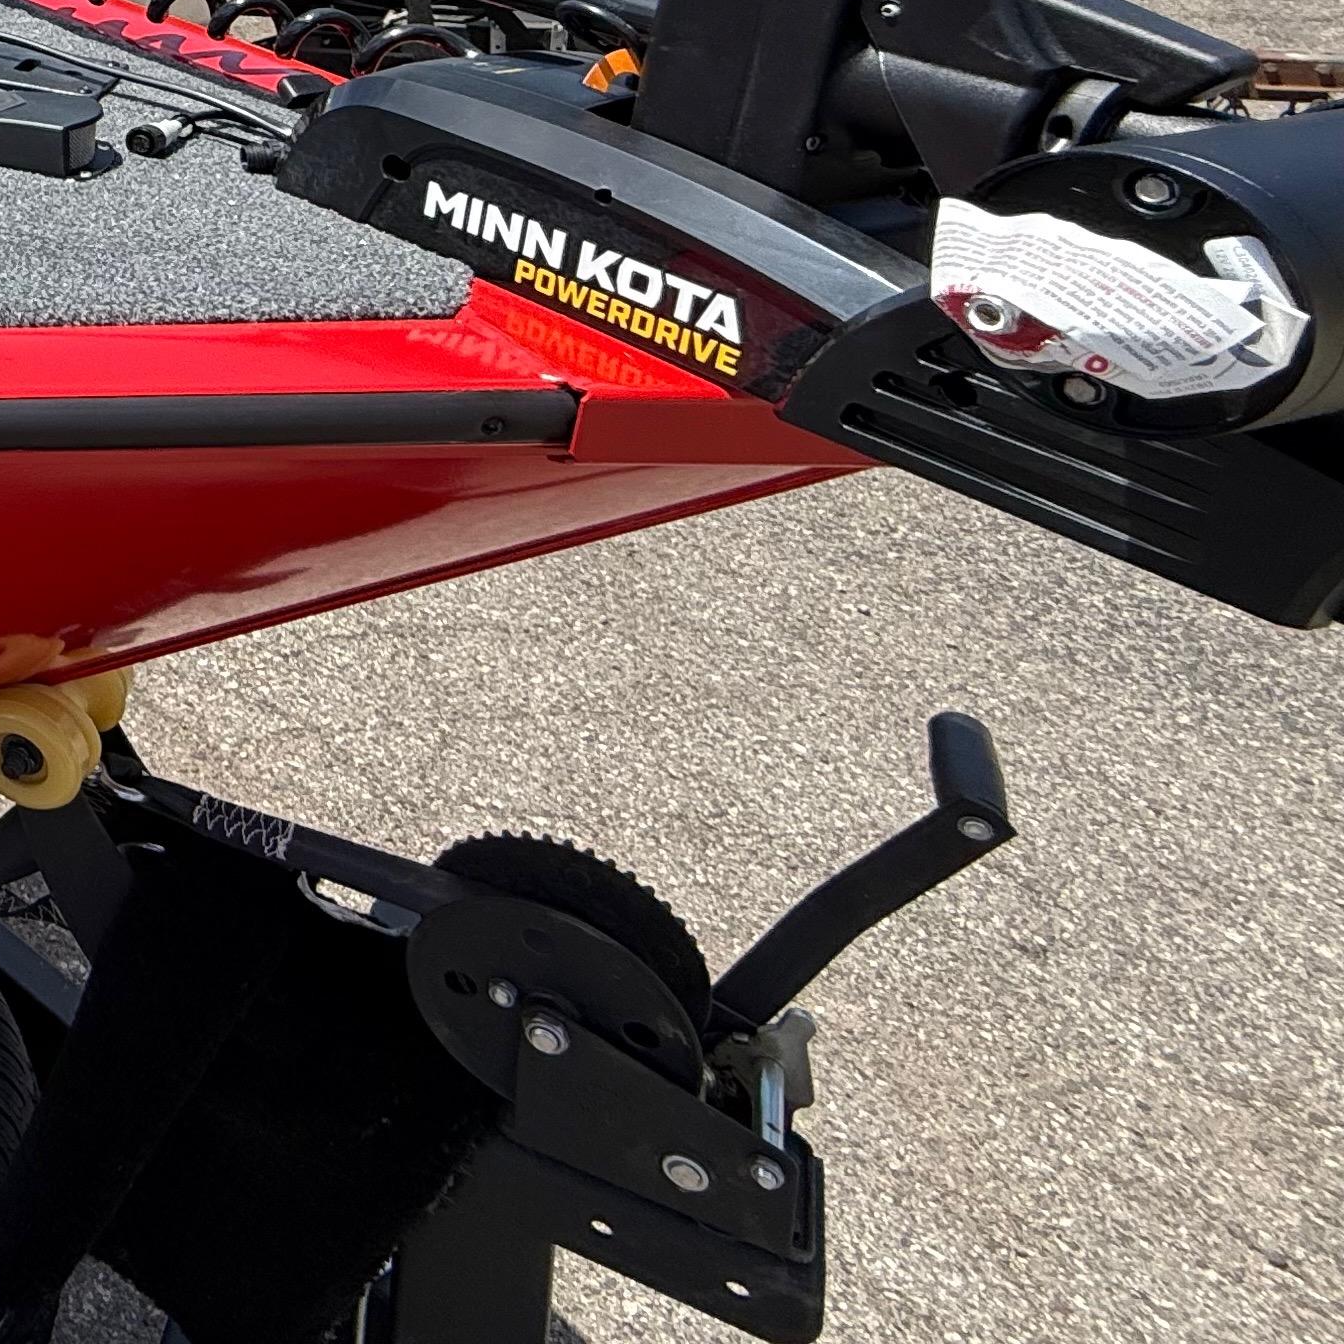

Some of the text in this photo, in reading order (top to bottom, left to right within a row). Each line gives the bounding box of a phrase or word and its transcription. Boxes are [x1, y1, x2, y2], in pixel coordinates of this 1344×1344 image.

[423, 179, 742, 345] MINN KOTA
[513, 258, 743, 377] POWERDRIVE
